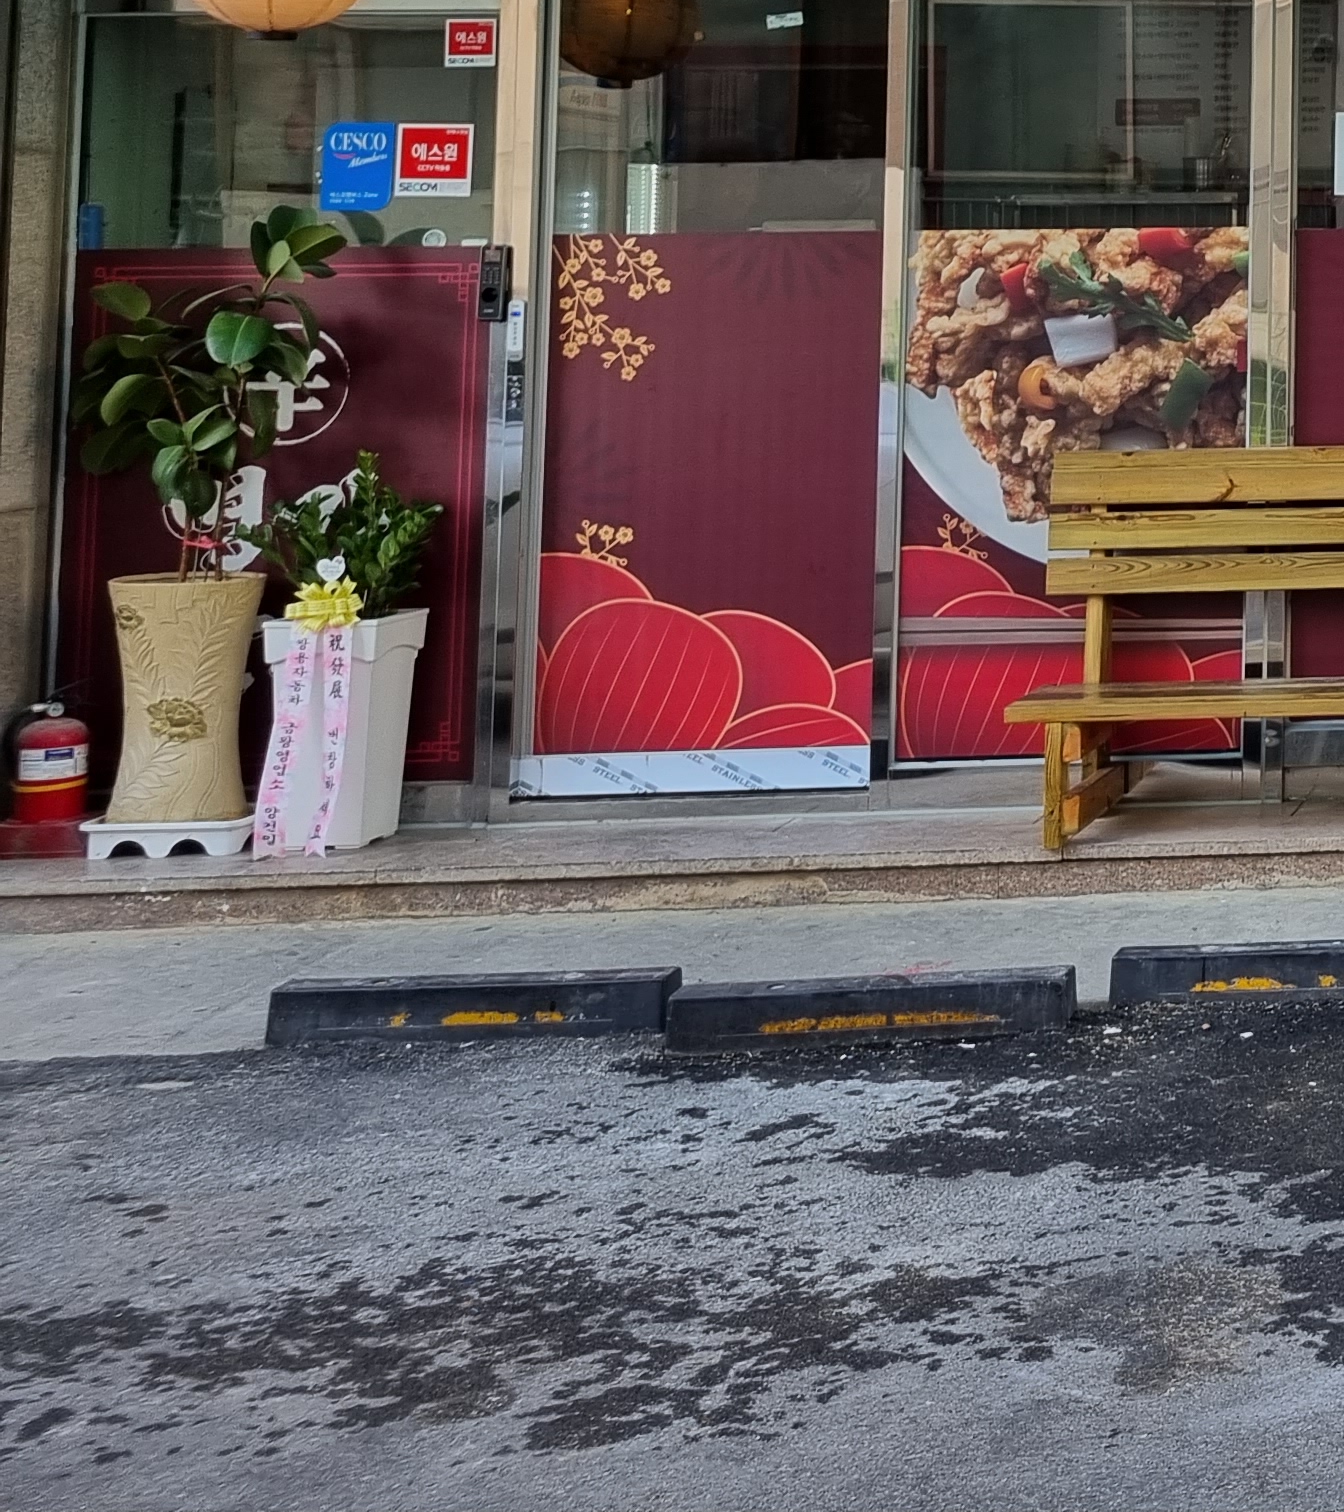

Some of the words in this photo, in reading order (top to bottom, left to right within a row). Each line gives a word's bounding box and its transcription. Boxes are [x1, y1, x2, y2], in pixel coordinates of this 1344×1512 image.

[456, 31, 488, 44] 에스원
[330, 132, 387, 151] CESCO
[411, 143, 459, 162] 에스원
[399, 182, 438, 193] SECOM
